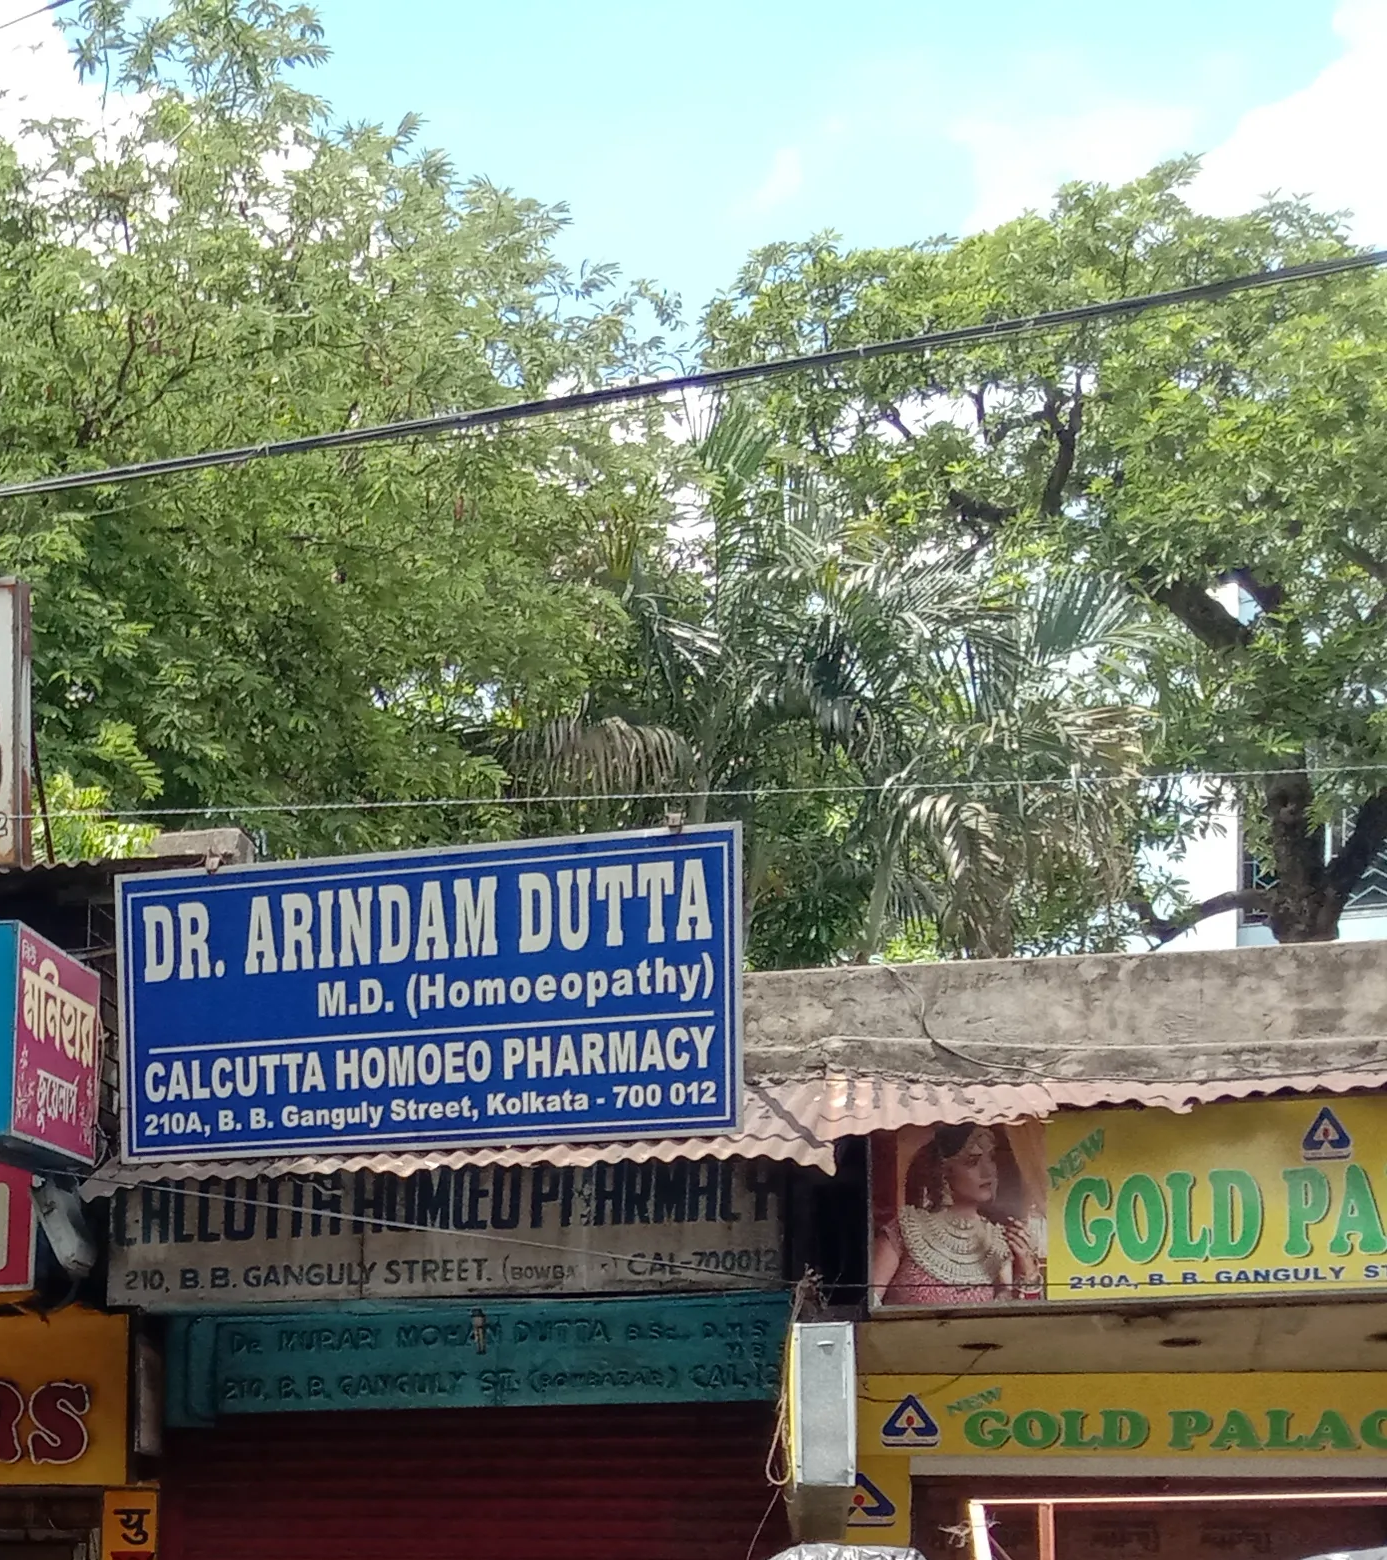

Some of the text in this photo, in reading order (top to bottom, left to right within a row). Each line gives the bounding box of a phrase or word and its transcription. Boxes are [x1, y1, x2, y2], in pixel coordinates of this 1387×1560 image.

[143, 858, 714, 983] DR. ARINDAM DUTTA
[23, 957, 97, 1069] মনিহার
[317, 951, 715, 1019] M.D. (Homoeopathy)
[145, 1025, 716, 1103] CALCUTTA HOMOEO PHARMACY
[145, 1111, 212, 1138] 210A,
[218, 1109, 245, 1132] B.
[250, 1107, 275, 1129] B.
[281, 1101, 384, 1132] Ganguly
[390, 1097, 480, 1123] Street,
[487, 1090, 590, 1116] Kolkata
[612, 1084, 662, 1110] 700
[671, 1082, 717, 1106] 012
[113, 1178, 343, 1247] CALCUTTA
[1047, 1127, 1265, 1267] NEW GOLD
[124, 1268, 171, 1293] 210,
[242, 1261, 380, 1288] GANGULY
[384, 1256, 493, 1284] STREET.
[626, 1248, 781, 1277] CAL-700012
[1069, 1275, 1140, 1289] 210A,
[1182, 1271, 1207, 1284] B.
[1215, 1266, 1346, 1284] GANGULY
[513, 1319, 611, 1346] DUTTA
[947, 1387, 1387, 1452] NEW GOLD PALAC
